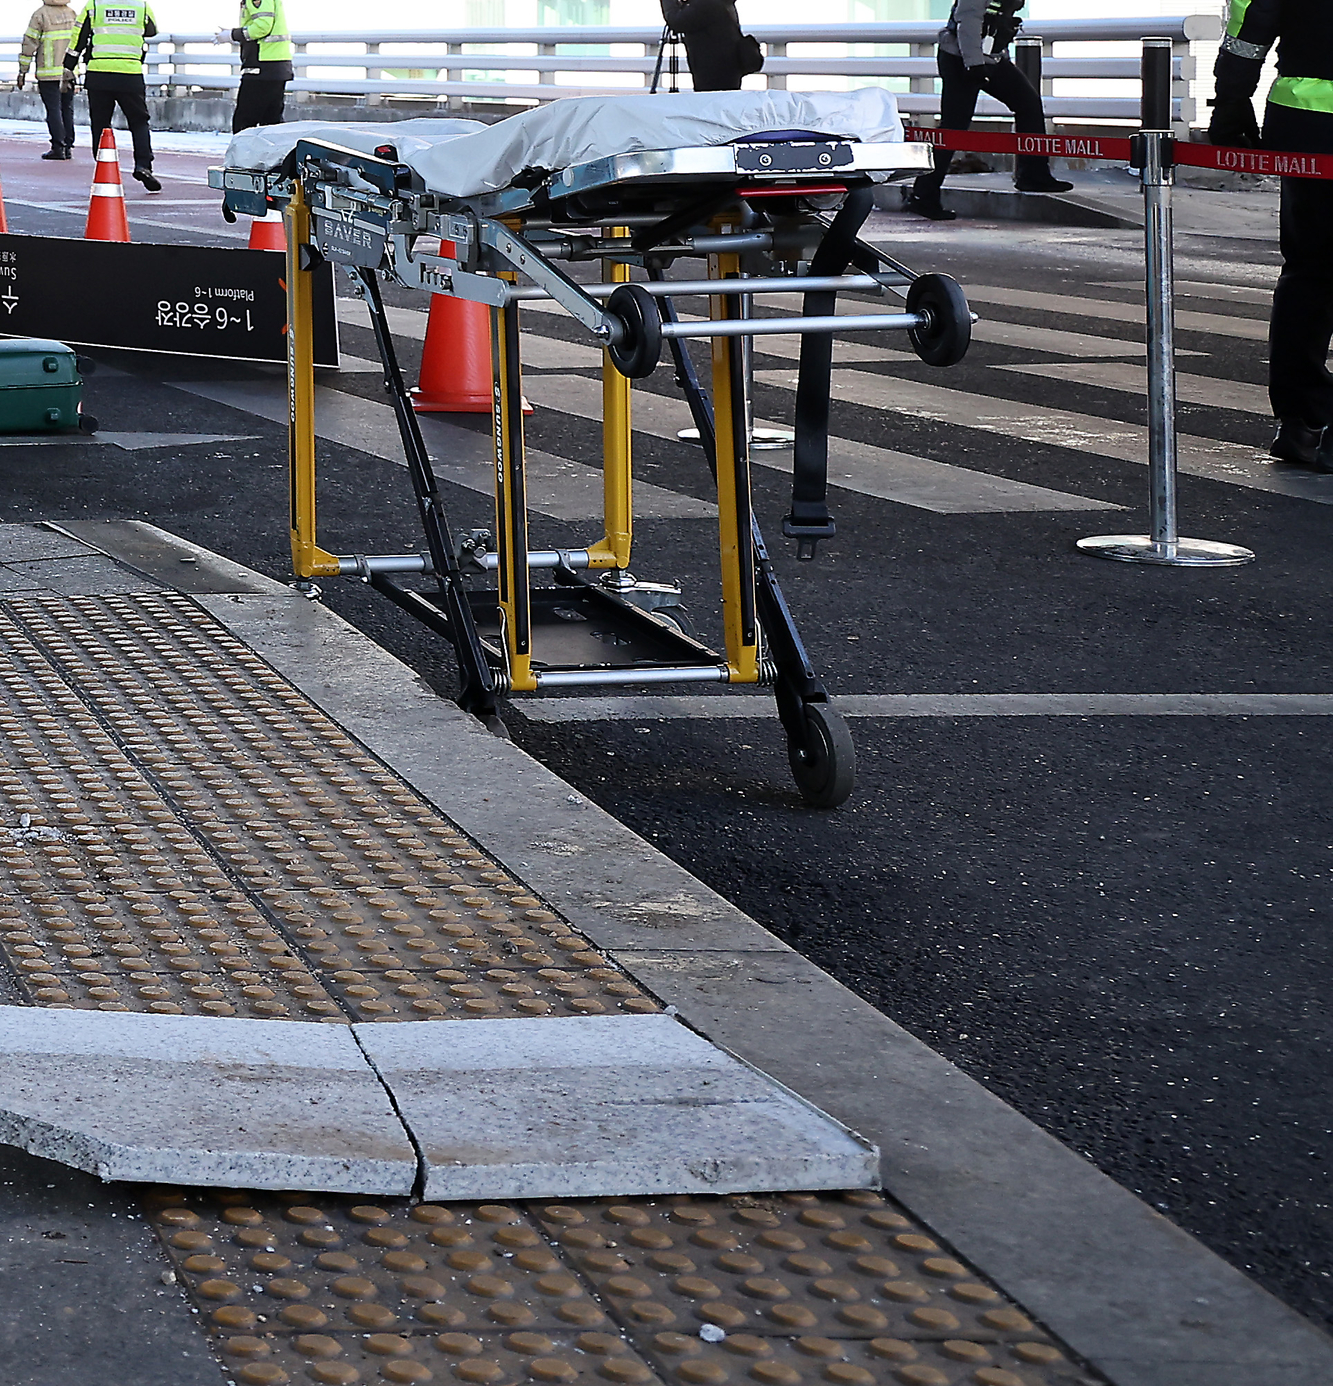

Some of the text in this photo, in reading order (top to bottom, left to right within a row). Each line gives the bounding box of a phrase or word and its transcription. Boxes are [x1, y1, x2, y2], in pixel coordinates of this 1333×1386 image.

[913, 129, 946, 147] MALL
[1017, 137, 1104, 157] LOTTE MALL
[1217, 151, 1321, 176] LOTTE MALL
[323, 219, 373, 250] SAVER
[194, 285, 255, 302] Platform 1~6
[155, 300, 212, 330] 승강장
[494, 403, 504, 483] SUNGWOO
